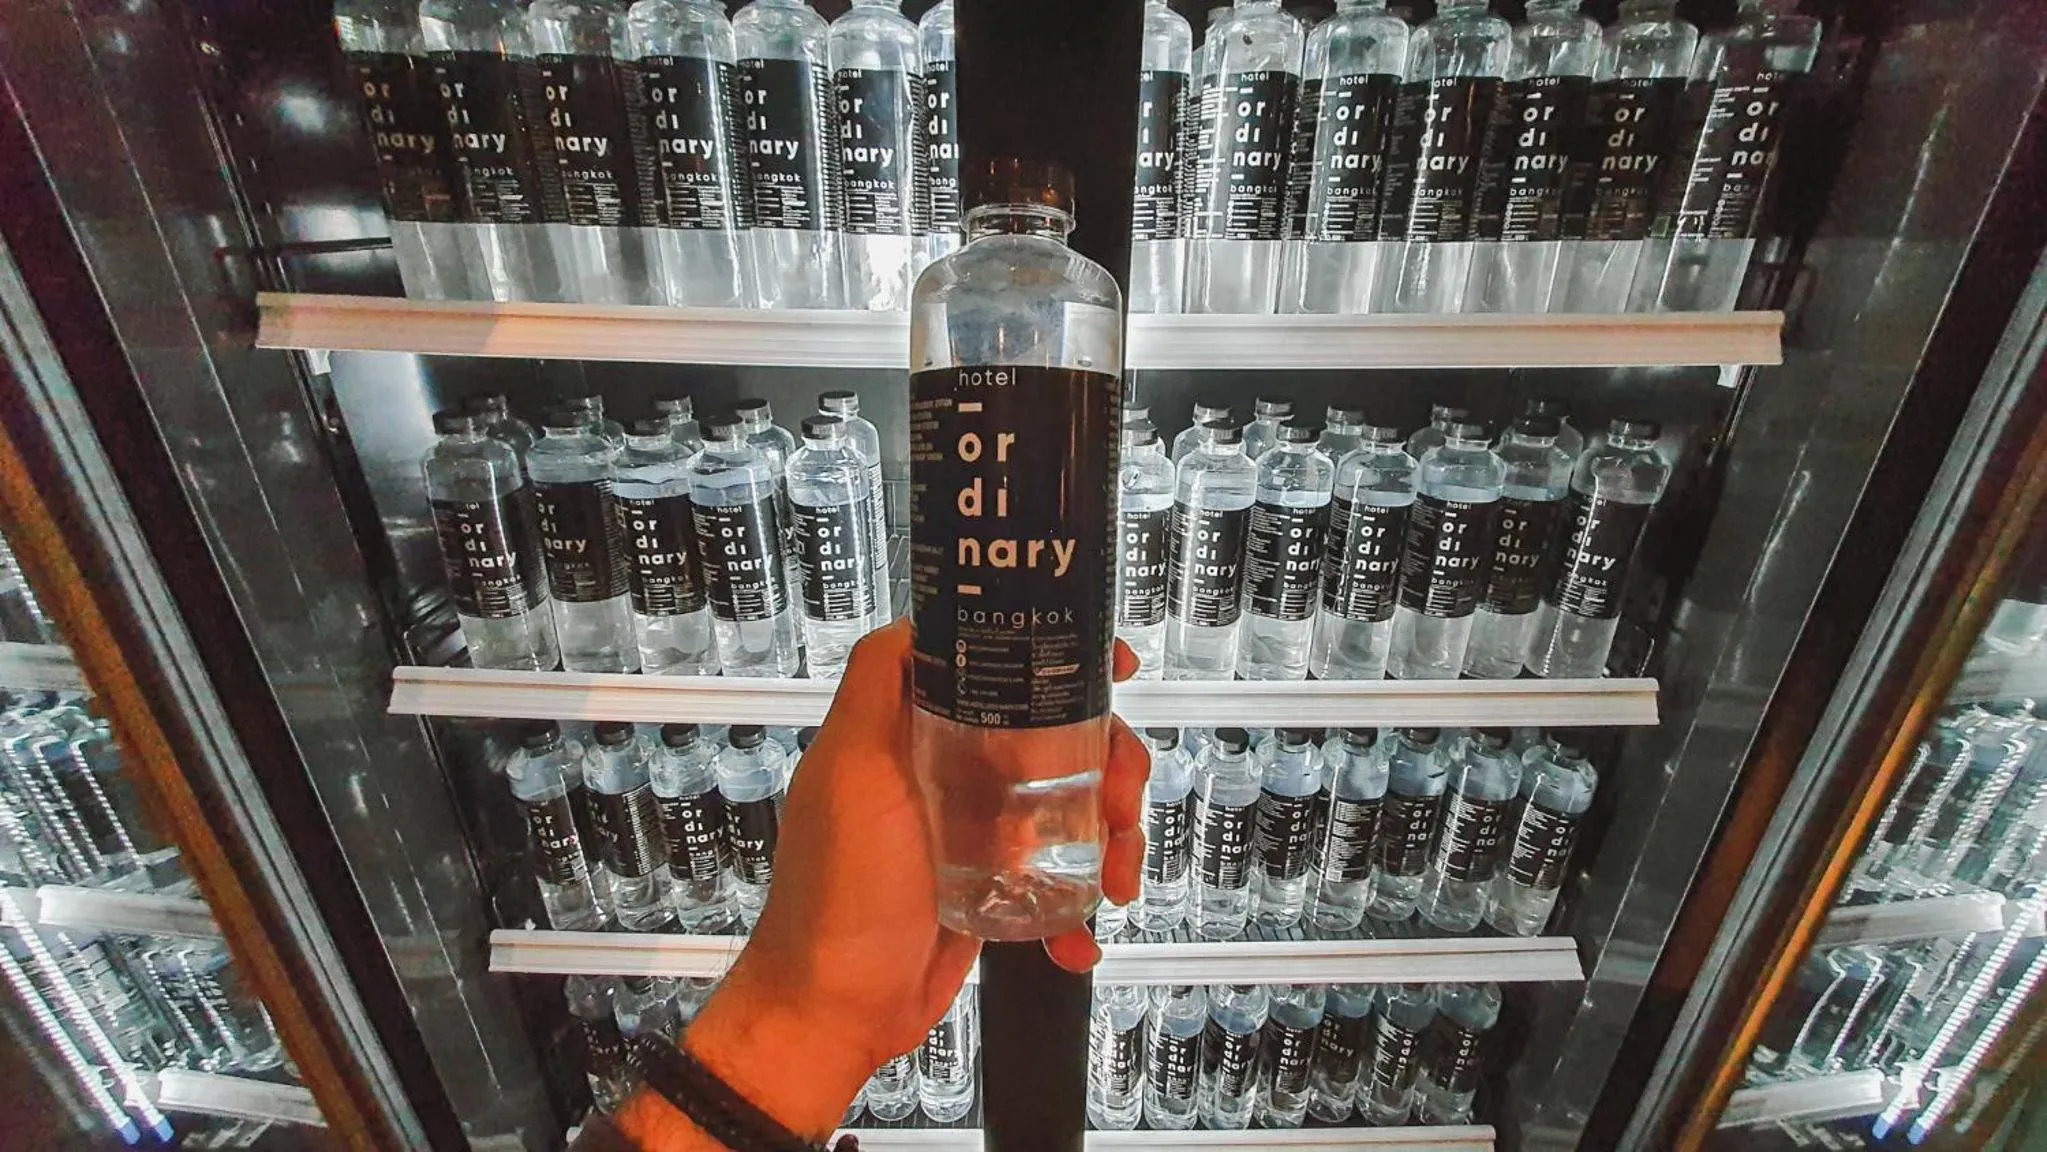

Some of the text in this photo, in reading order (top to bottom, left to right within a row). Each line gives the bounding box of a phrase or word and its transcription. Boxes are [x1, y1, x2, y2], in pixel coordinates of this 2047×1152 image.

[1433, 78, 1456, 88] otel
[453, 133, 506, 153] nary
[556, 135, 608, 157] nary
[660, 139, 713, 160] nary
[749, 138, 799, 160] nary
[843, 145, 894, 167] nary
[1232, 151, 1282, 171] nary
[1330, 153, 1380, 173] nary
[1417, 155, 1469, 175] nary
[1515, 155, 1568, 174] nary
[1602, 154, 1658, 174] nary
[960, 368, 1016, 386] hotel
[958, 539, 1076, 577] nary
[957, 606, 1074, 629] bangkok
[981, 711, 1001, 725] 500
